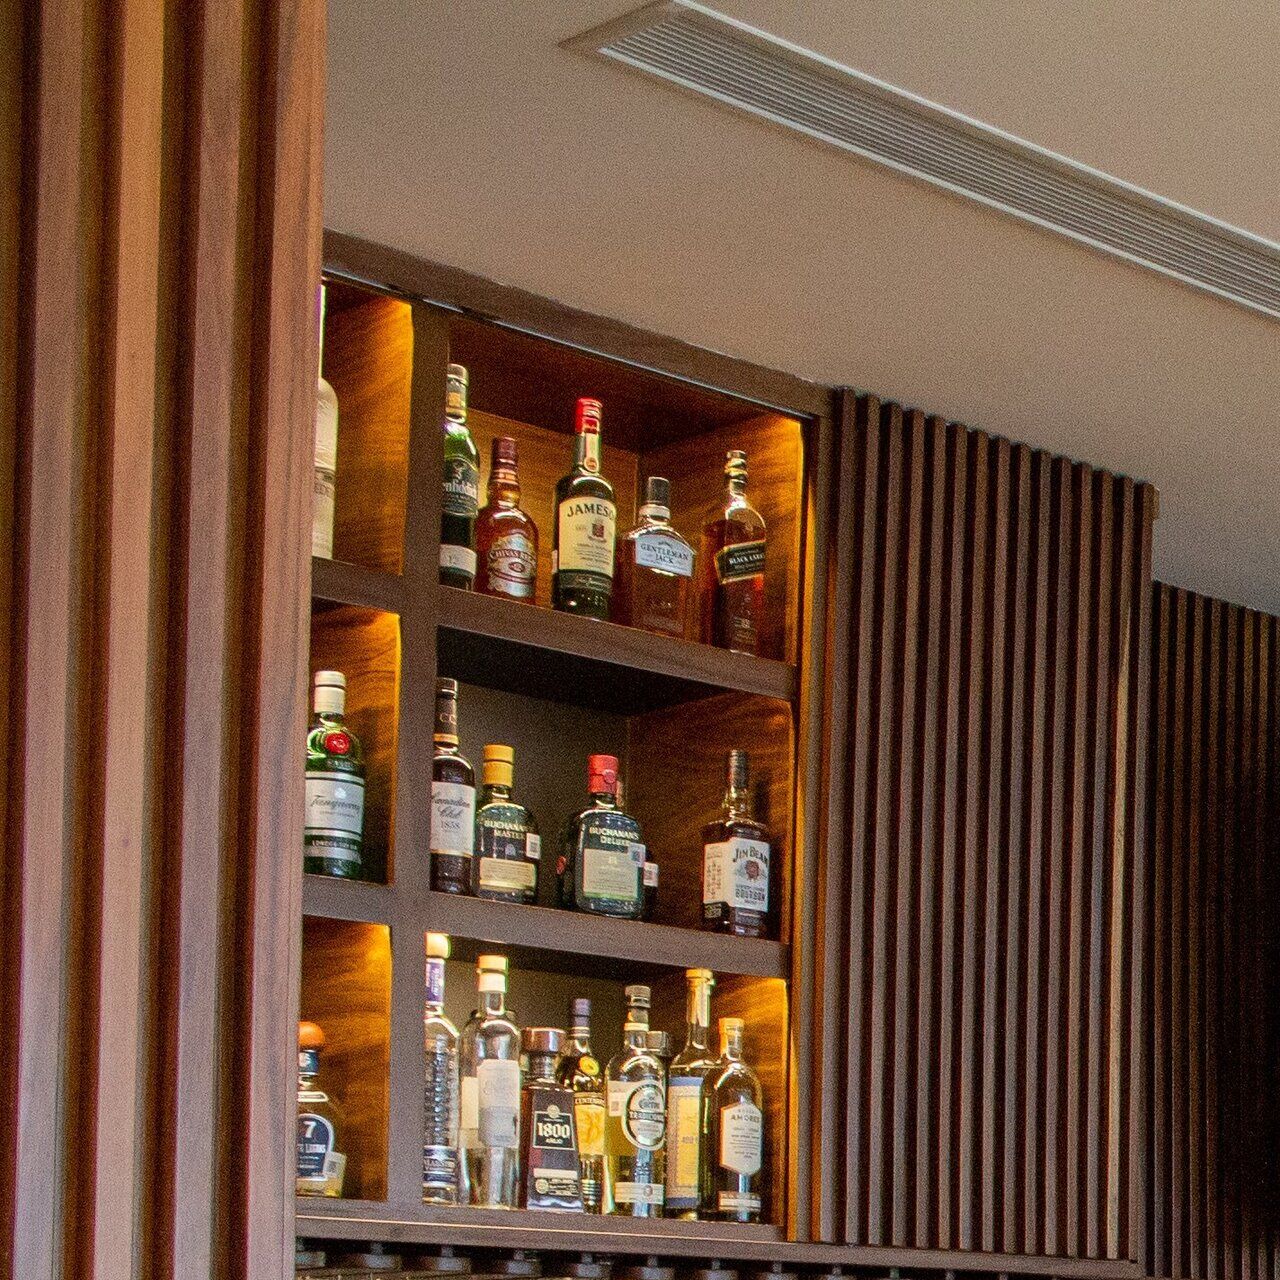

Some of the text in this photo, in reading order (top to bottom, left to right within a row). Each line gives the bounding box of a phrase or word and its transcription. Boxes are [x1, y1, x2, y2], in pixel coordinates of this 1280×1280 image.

[489, 549, 521, 561] CHIVAS
[640, 543, 689, 561] GENTLEMAN
[655, 552, 675, 565] JACK
[728, 555, 749, 566] BLACK
[732, 848, 748, 862] JIM
[303, 1121, 317, 1138] 7
[537, 1122, 570, 1139] 1800
